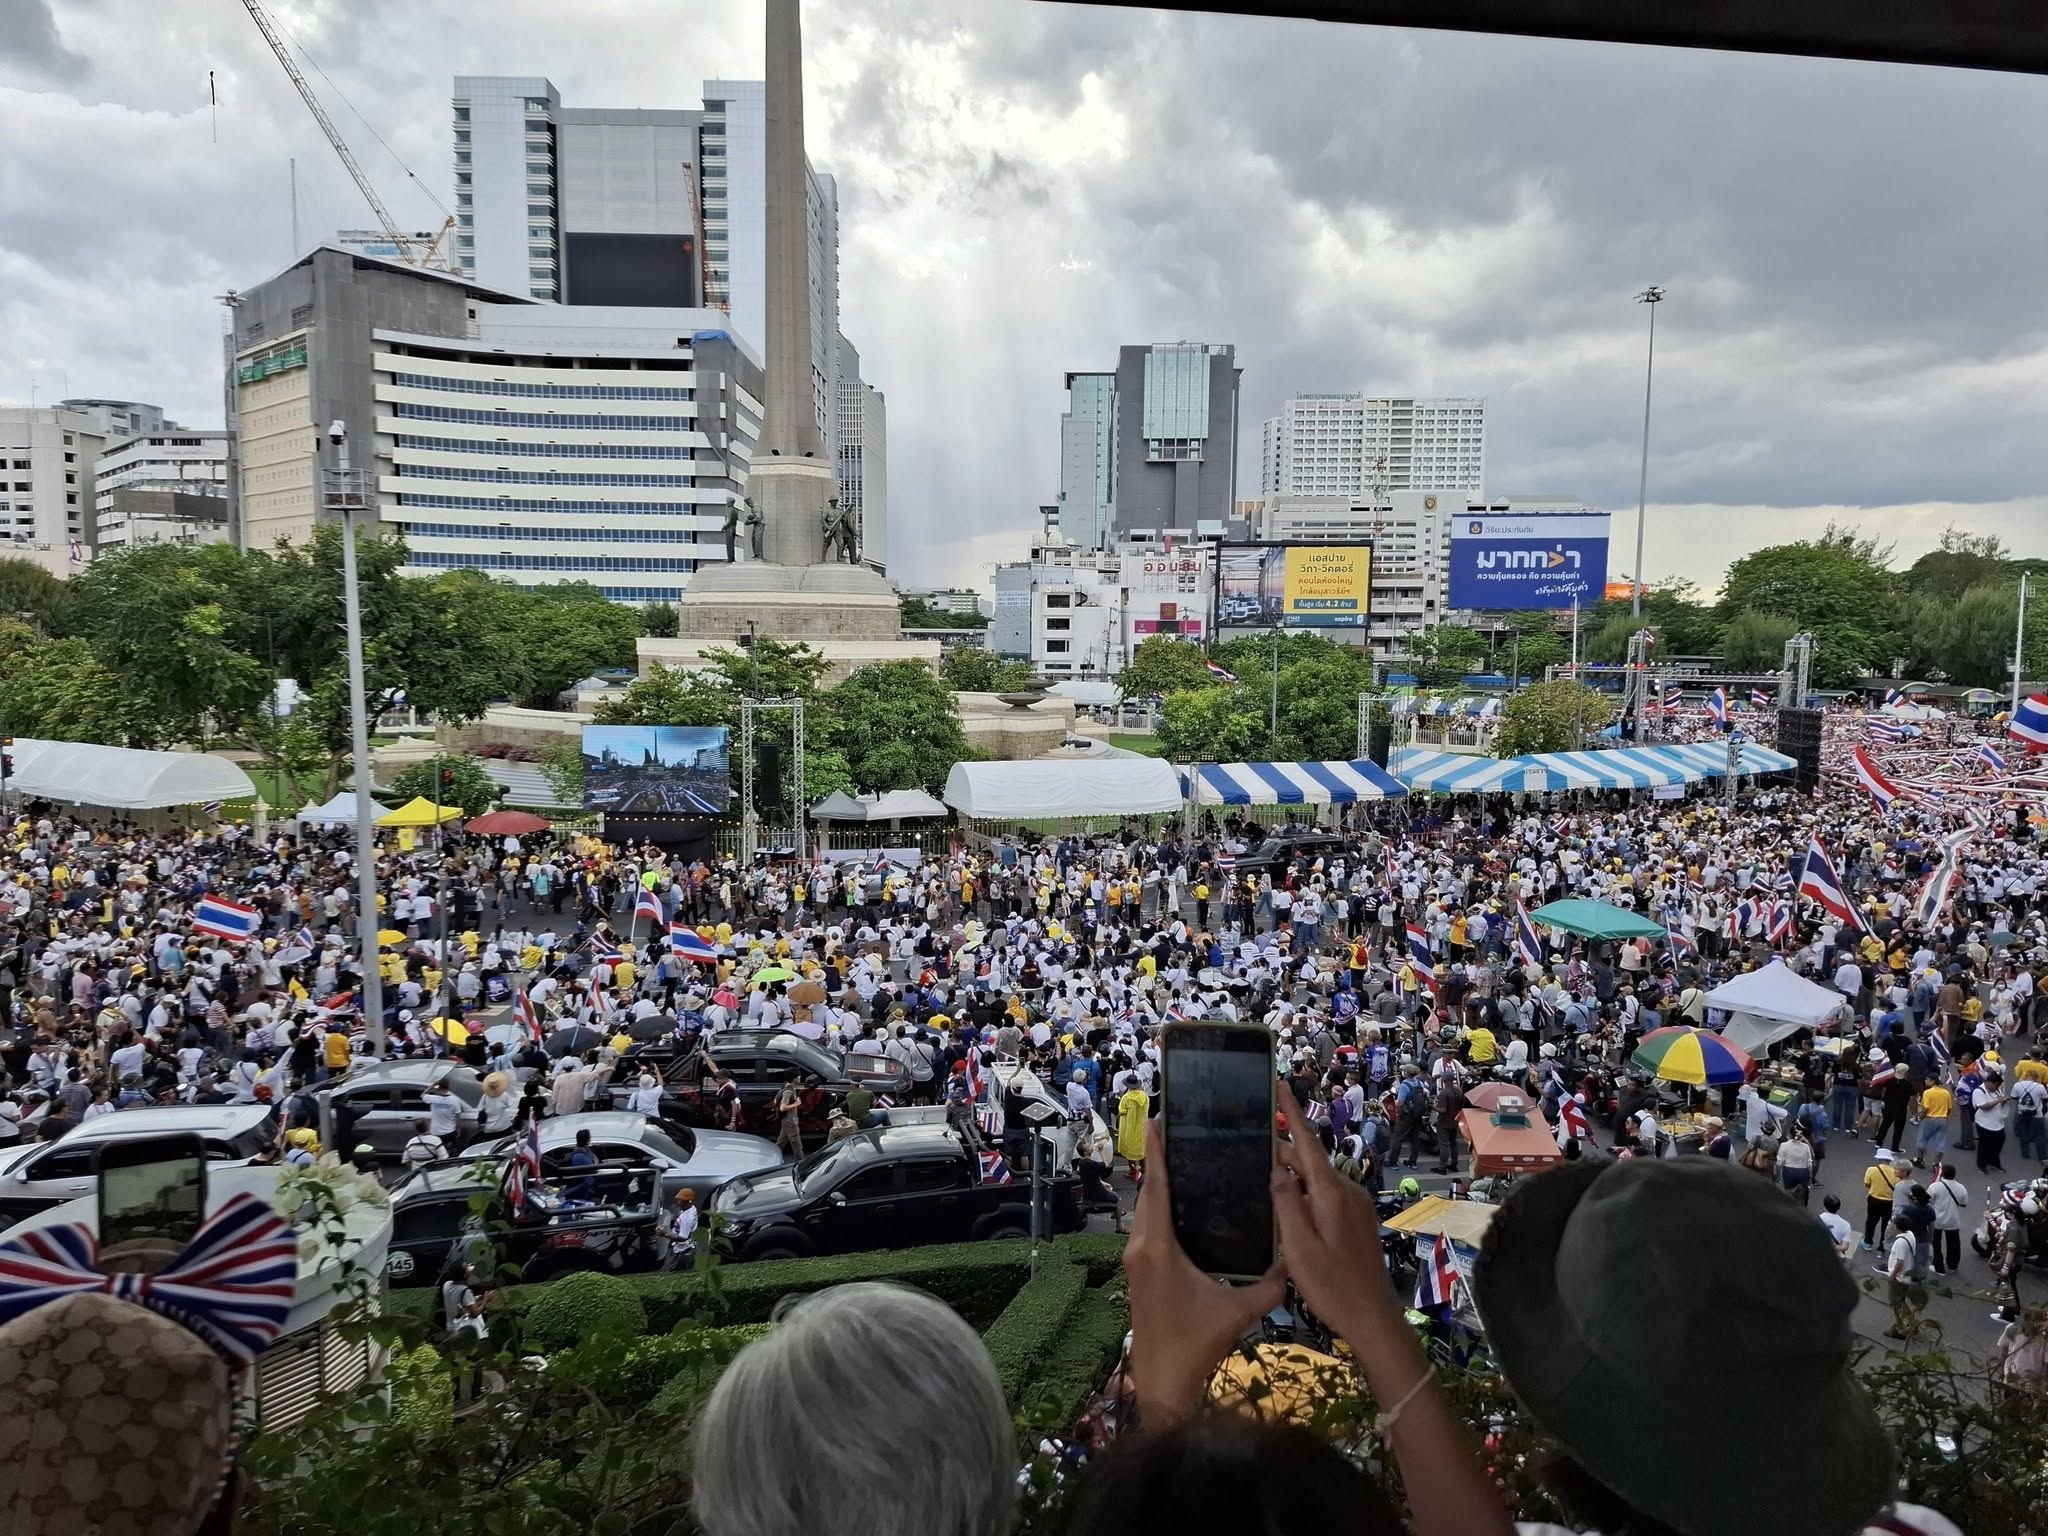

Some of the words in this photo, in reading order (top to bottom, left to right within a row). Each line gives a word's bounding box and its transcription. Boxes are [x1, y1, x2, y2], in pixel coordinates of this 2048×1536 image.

[1309, 553, 1346, 562] แอสปาย
[1477, 571, 1527, 581] ความคุ้มครอง
[1528, 571, 1539, 580] คือ
[1541, 570, 1580, 581] ความคุ้มค่า
[1298, 576, 1353, 585] คอนโดห้องใหญ่
